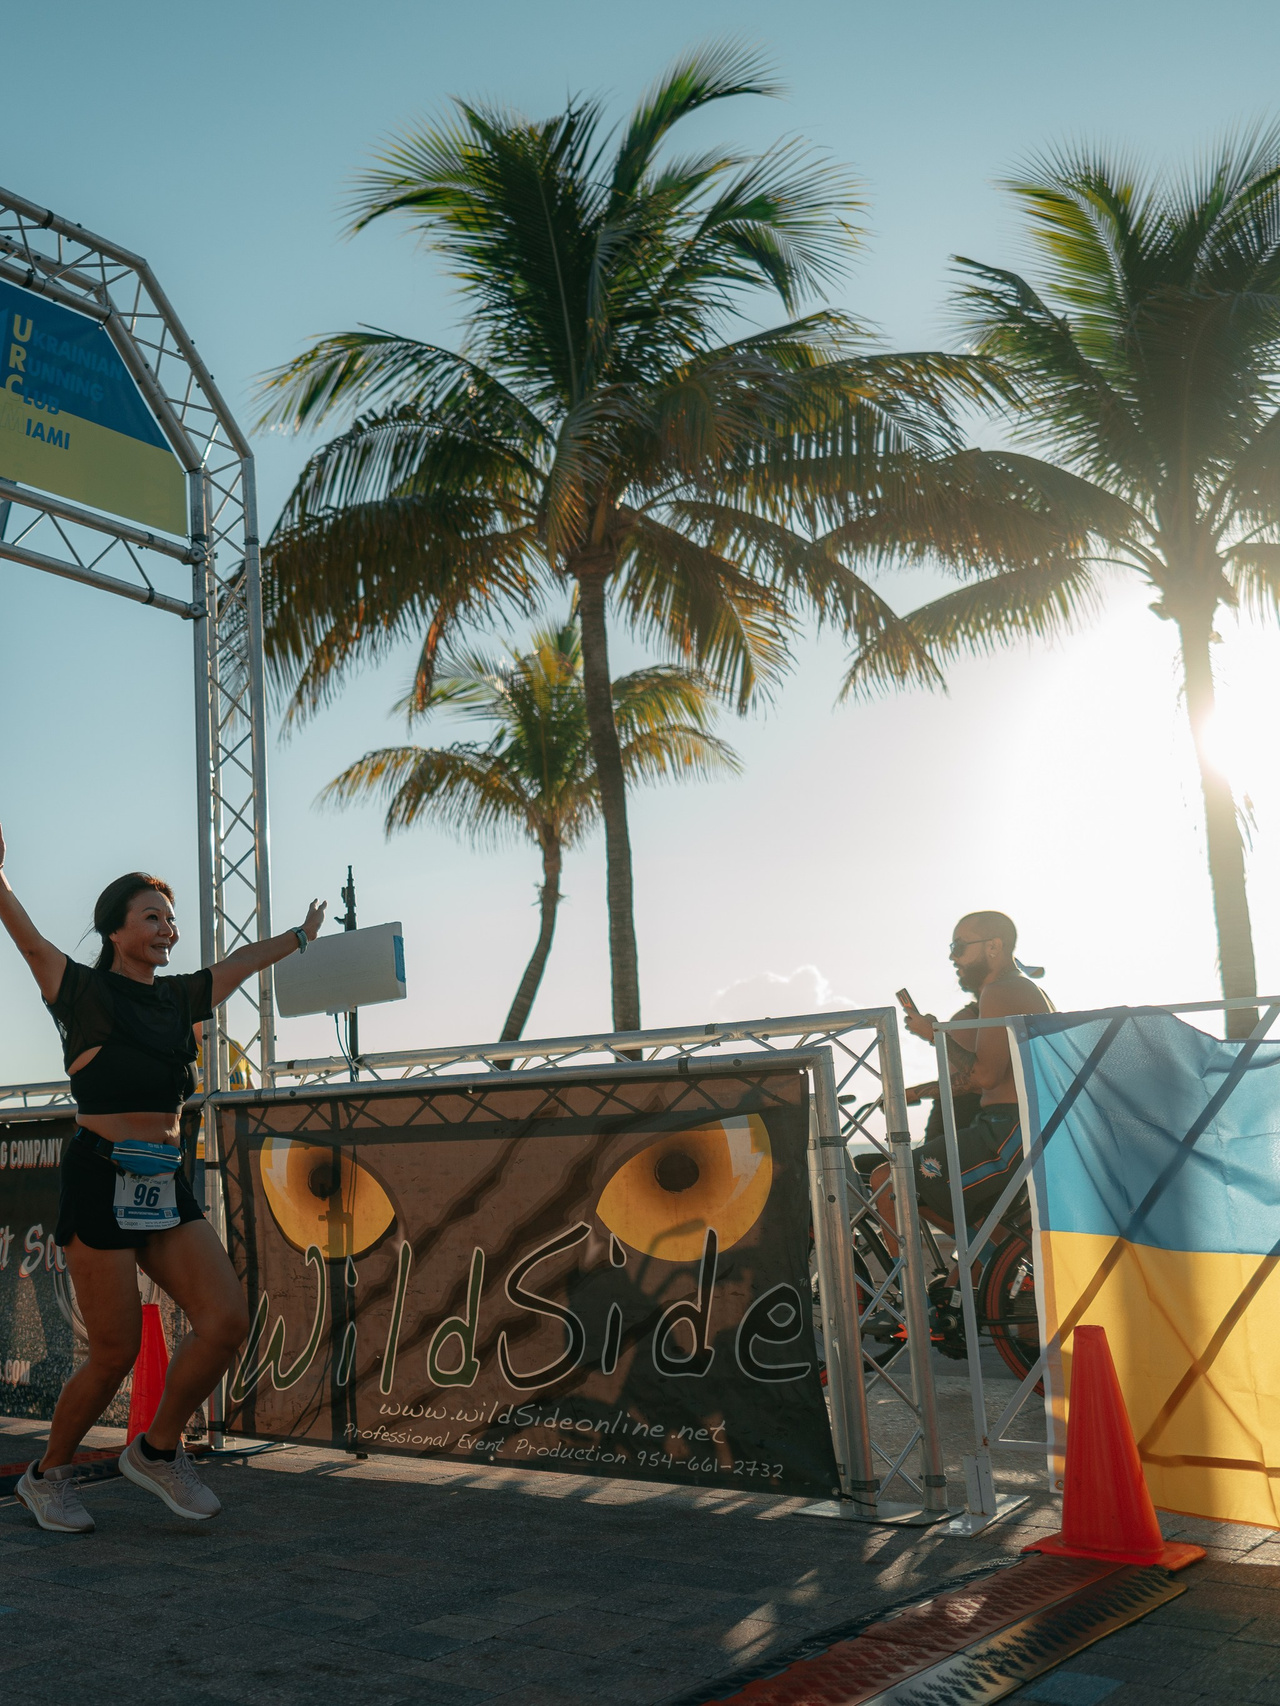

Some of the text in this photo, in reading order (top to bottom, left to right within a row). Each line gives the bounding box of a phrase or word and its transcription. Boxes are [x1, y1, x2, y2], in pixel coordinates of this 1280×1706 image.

[13, 314, 124, 381] UKRAINIAN
[5, 374, 60, 415] CLUB
[8, 343, 105, 403] RUNNING
[9, 1138, 63, 1170] COMPANY
[134, 1183, 160, 1208] 96
[379, 1400, 726, 1444] www.wildSideonline.net
[344, 1422, 784, 1479] Professional Event Production 954-661-2732
